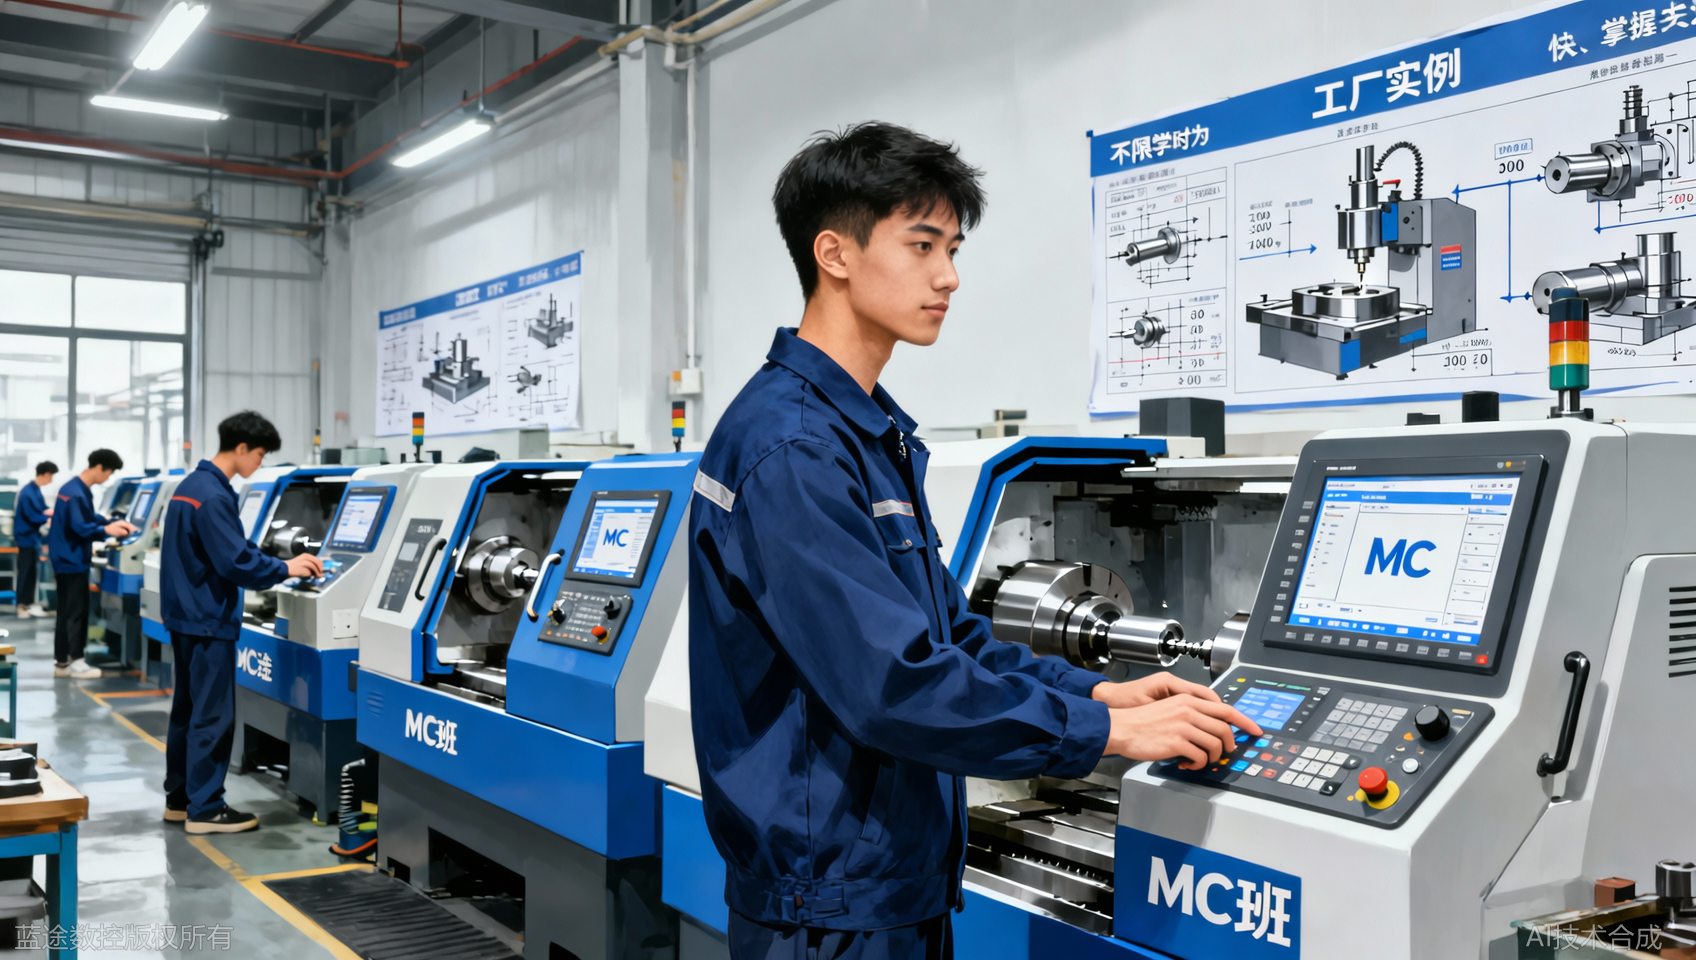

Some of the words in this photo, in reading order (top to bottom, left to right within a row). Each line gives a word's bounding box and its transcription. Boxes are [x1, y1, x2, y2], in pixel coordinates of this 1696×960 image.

[1312, 47, 1462, 119] 工厂实例
[603, 528, 630, 548] MC
[1364, 537, 1437, 578] MC
[405, 708, 458, 756] MC班
[1148, 855, 1292, 948] MC班
